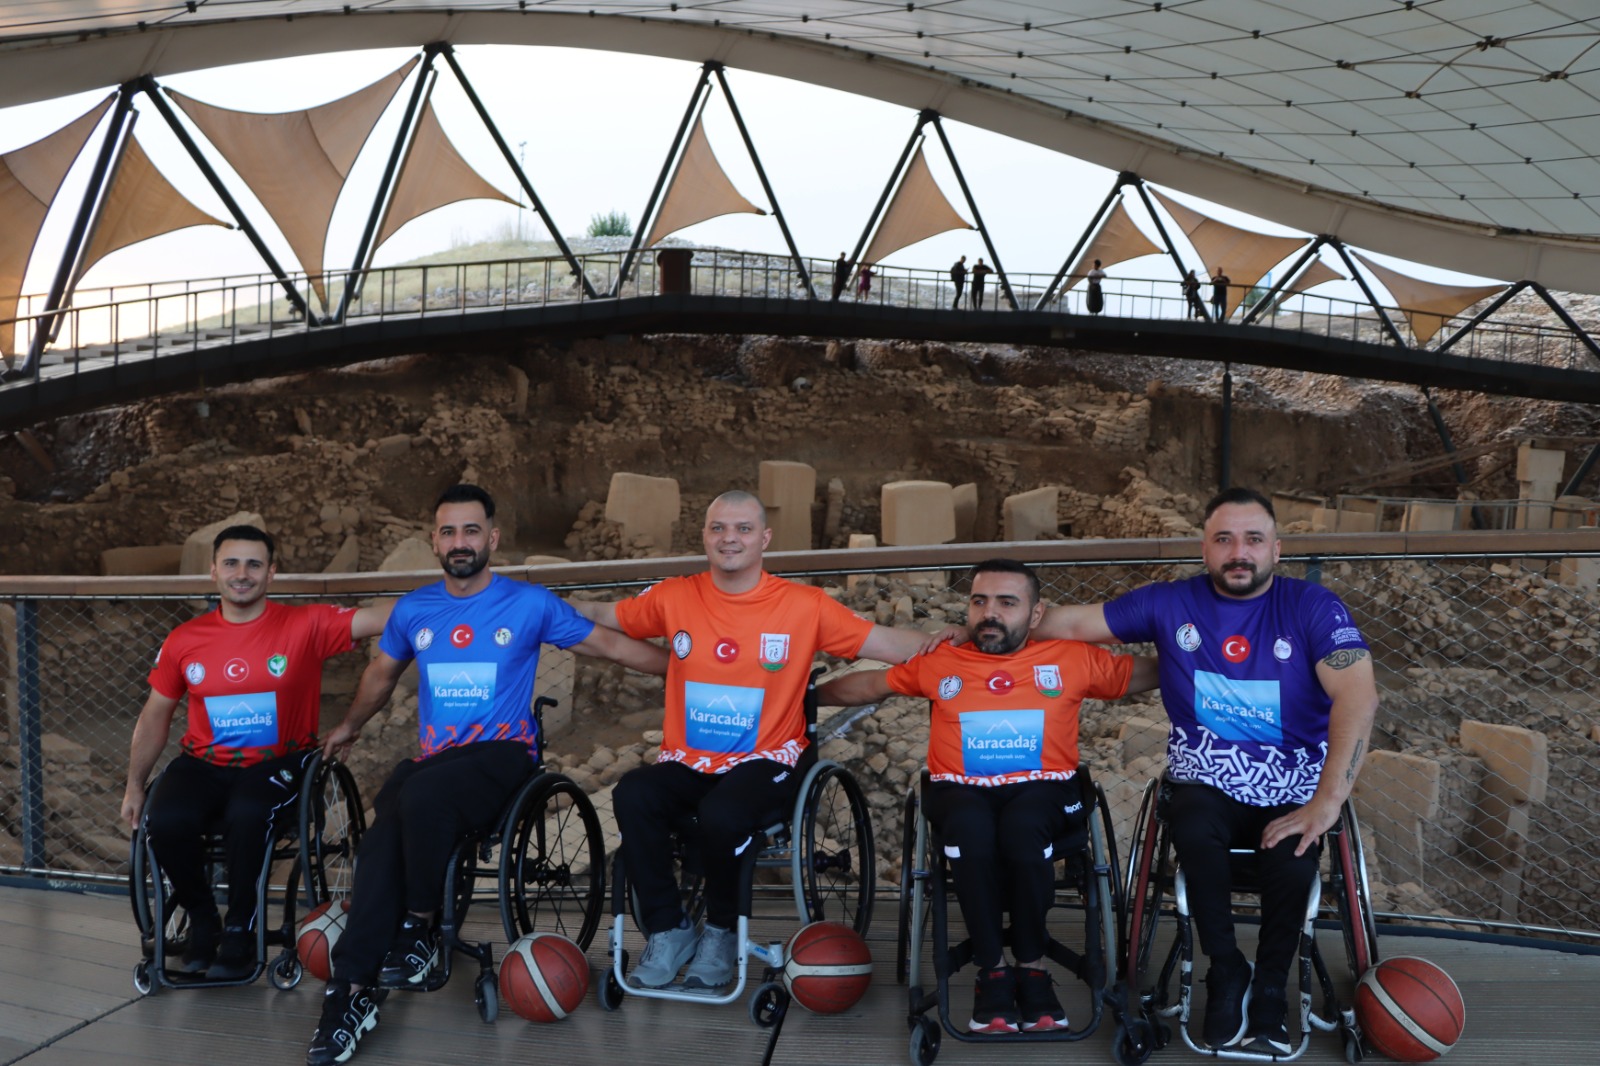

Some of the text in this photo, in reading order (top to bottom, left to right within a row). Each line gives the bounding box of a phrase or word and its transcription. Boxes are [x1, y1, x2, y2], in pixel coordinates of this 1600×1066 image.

[434, 685, 490, 700] Karacadağ
[689, 707, 755, 731] Karacadağ
[1202, 696, 1275, 724] Karacadağ
[212, 712, 273, 728] Karacadağ
[967, 734, 1037, 752] Karacadağ
